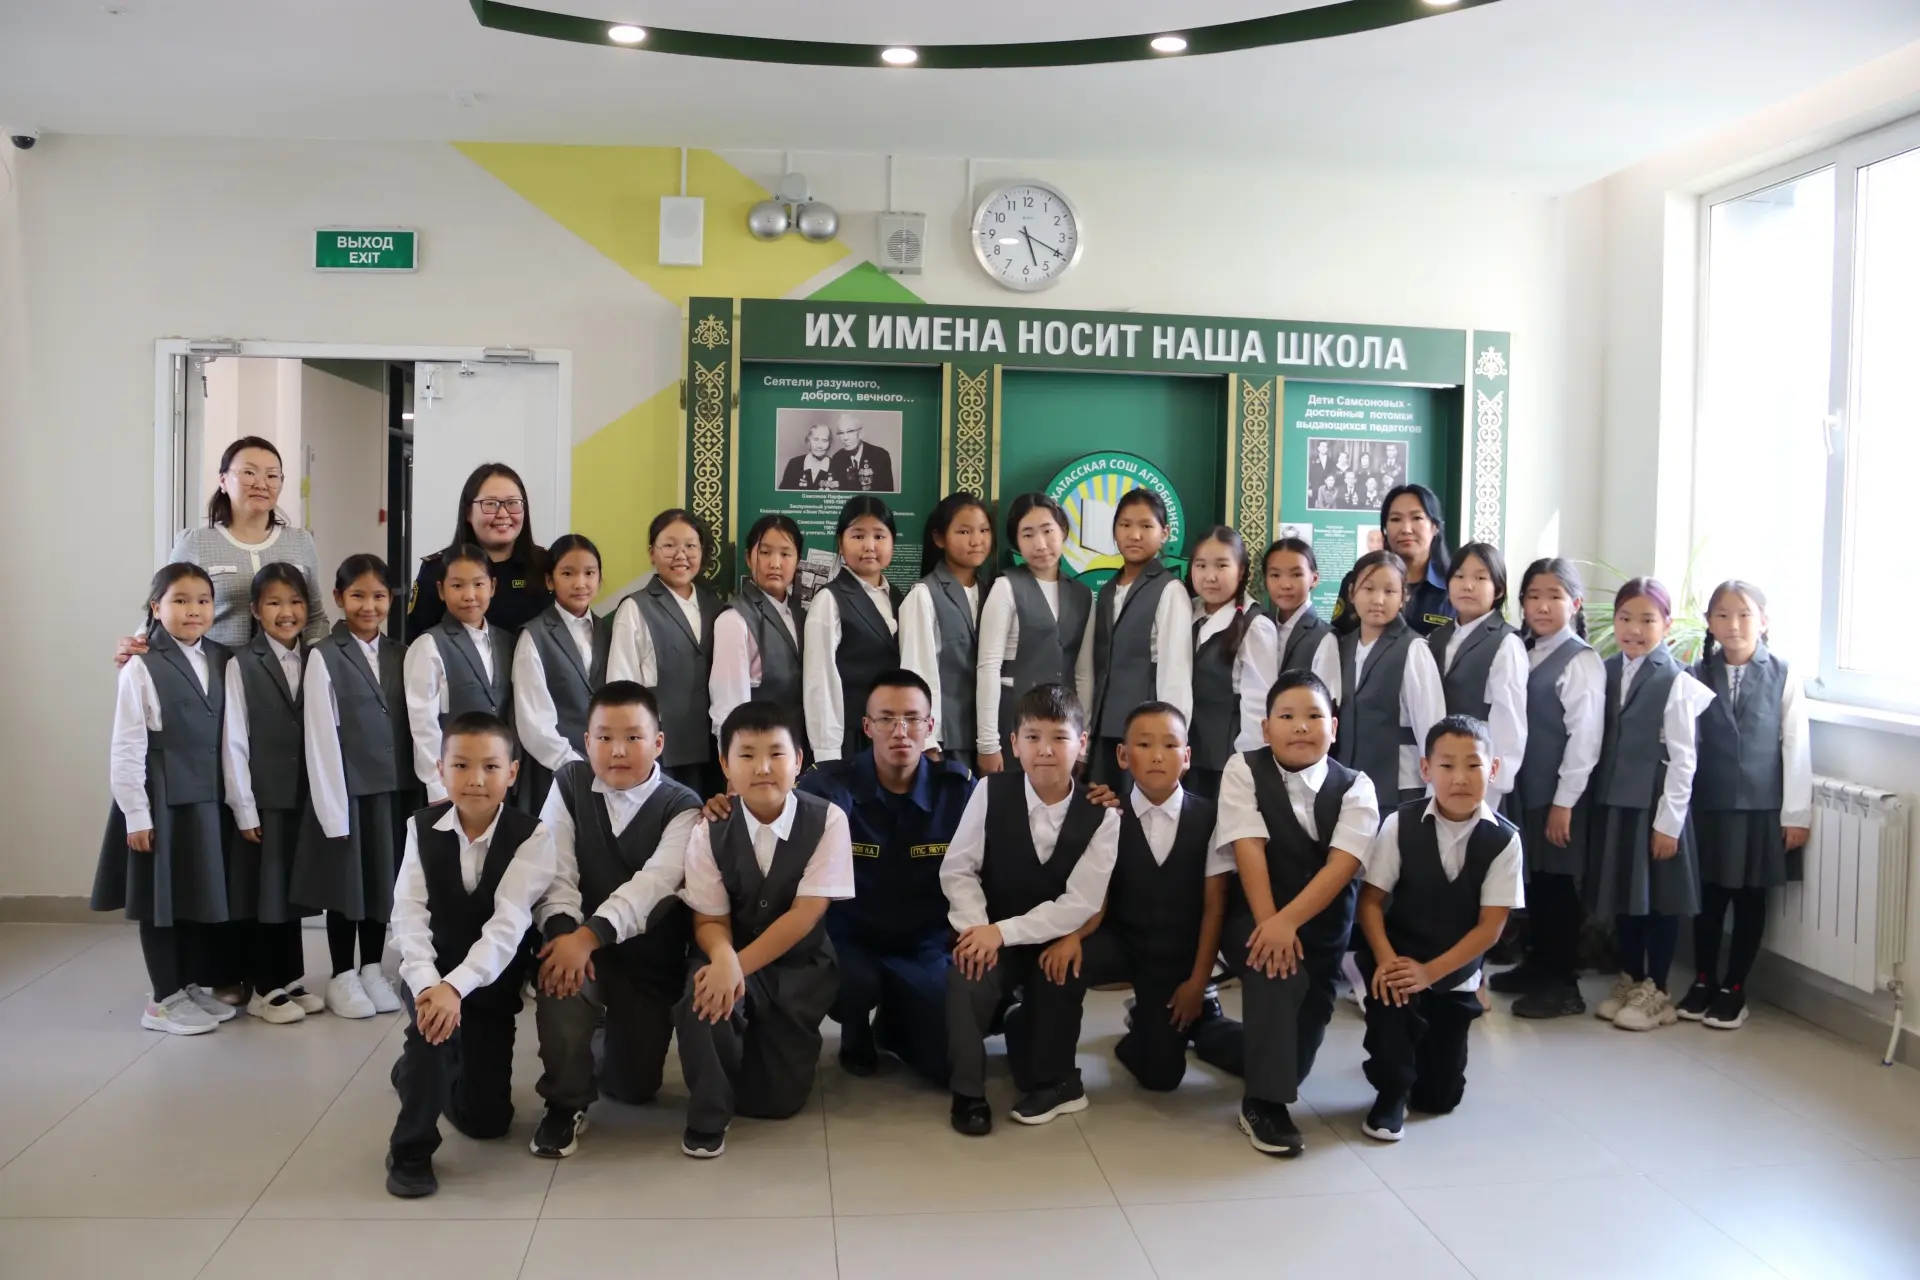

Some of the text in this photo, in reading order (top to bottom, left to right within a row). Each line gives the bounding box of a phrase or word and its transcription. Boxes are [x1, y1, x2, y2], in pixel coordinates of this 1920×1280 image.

[1007, 201, 1016, 211] 11
[1023, 197, 1034, 207] 12
[995, 213, 1006, 223] 10
[1053, 216, 1061, 226] 2
[989, 229, 996, 239] 9
[1059, 233, 1066, 243] 3
[337, 236, 394, 250] ВЫХОД
[994, 245, 1001, 255] 8
[1053, 249, 1060, 258] 4
[349, 252, 381, 263] EXIT
[1005, 259, 1012, 269] 7
[1042, 261, 1049, 271] 5
[1022, 265, 1030, 275] 6
[805, 312, 1408, 370] ИХ ИМЕНА НОСИТ НАША ШКОЛА
[763, 376, 880, 390] Сеятели разумного,
[801, 390, 914, 403] доброго, вечного...
[1308, 394, 1334, 406] Дети
[1337, 396, 1405, 408] Самсоновых
[1305, 408, 1414, 420] достойные потомки
[1296, 420, 1422, 433] выдающихся педагогов
[1050, 459, 1180, 543] ХАТАССКАЯ СОШ АГРОБИЗНЕСА
[929, 845, 949, 854] ЯКУТИ
